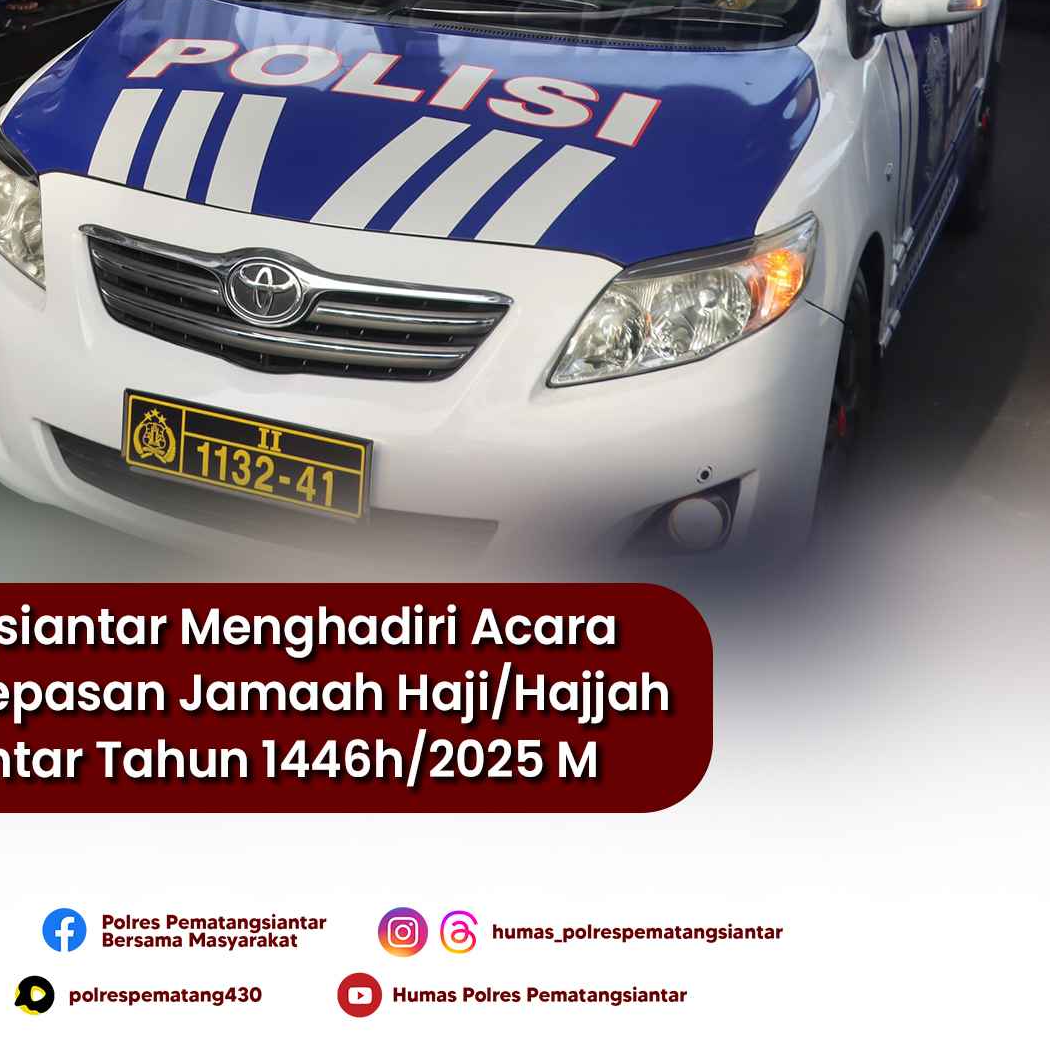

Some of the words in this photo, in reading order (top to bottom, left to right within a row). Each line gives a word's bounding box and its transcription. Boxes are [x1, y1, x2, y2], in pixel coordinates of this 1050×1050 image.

[127, 38, 661, 148] POLISI
[196, 440, 335, 508] 1132-41
[257, 426, 284, 454] II
